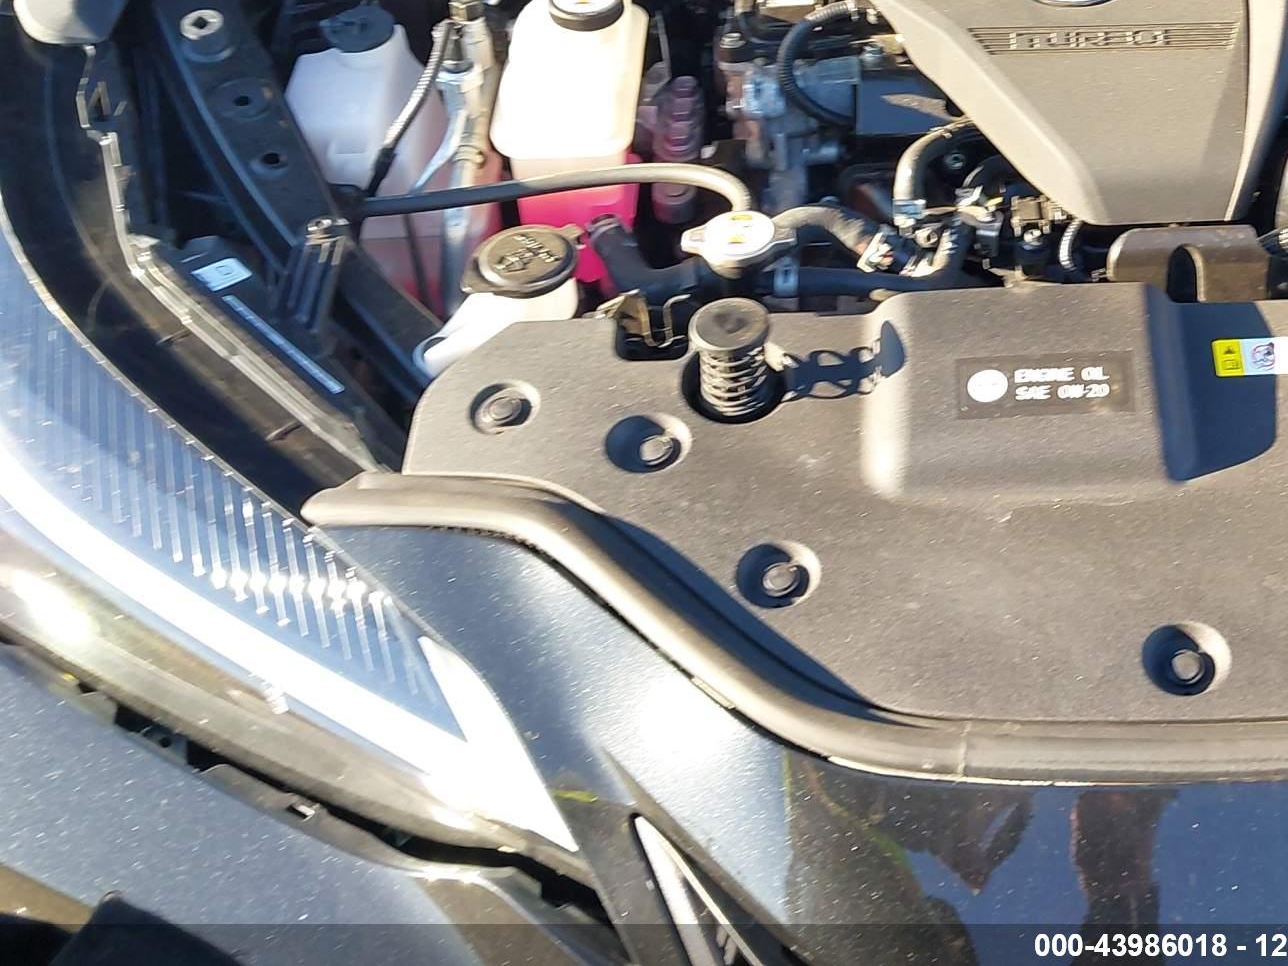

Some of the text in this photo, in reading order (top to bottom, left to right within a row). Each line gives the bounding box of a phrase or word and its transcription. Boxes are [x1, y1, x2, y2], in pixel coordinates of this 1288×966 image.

[1015, 29, 1165, 49] TURBO
[1081, 366, 1110, 381] OIL
[1015, 384, 1110, 400] SAE 0W-20
